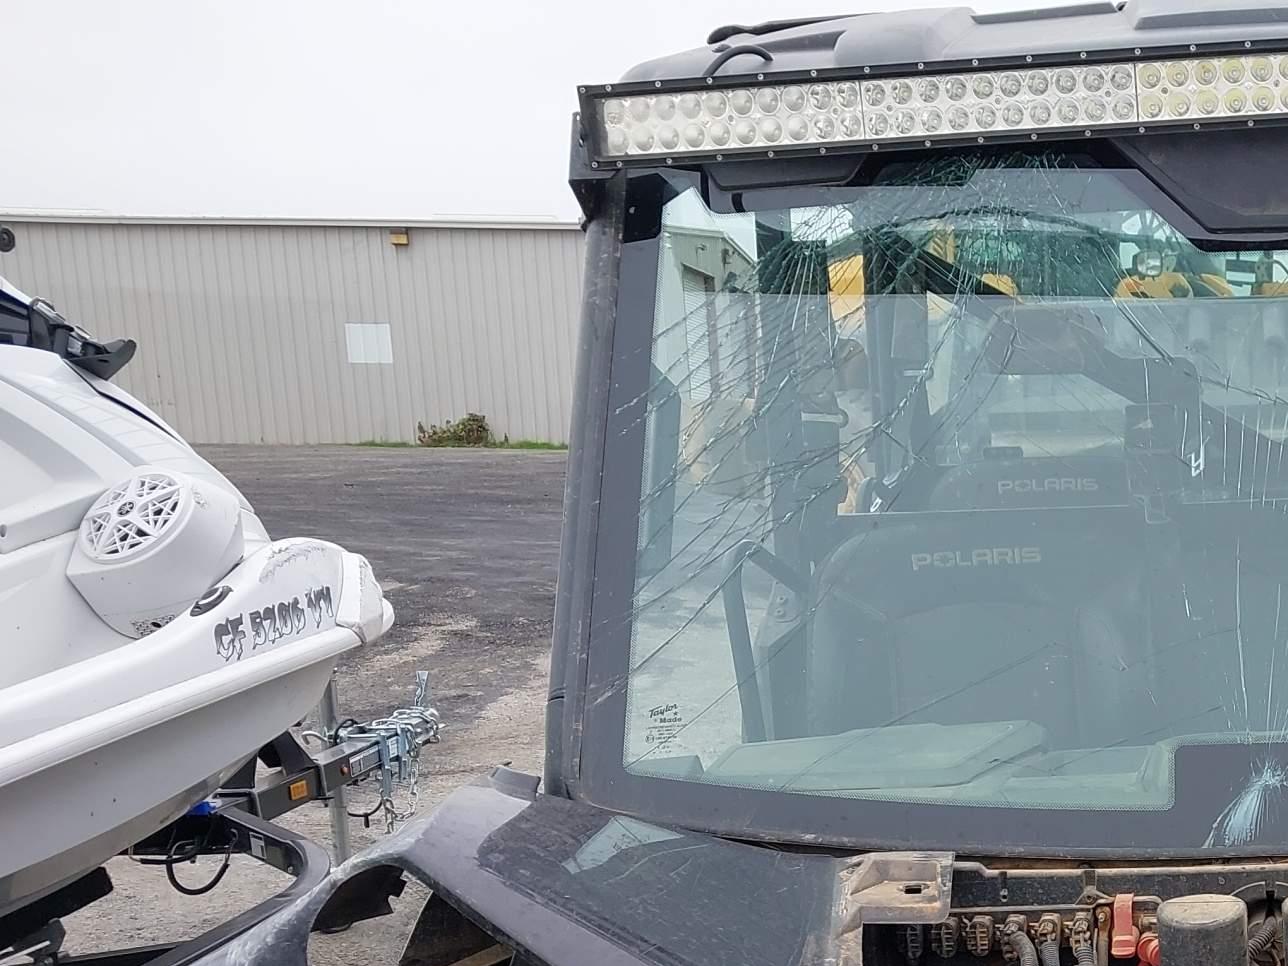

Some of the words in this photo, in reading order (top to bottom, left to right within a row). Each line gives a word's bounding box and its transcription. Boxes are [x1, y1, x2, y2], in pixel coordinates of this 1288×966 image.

[997, 478, 1099, 494] POLARIS
[911, 546, 1042, 571] POLARIS
[214, 612, 246, 661] CF
[648, 703, 678, 718] Taylor
